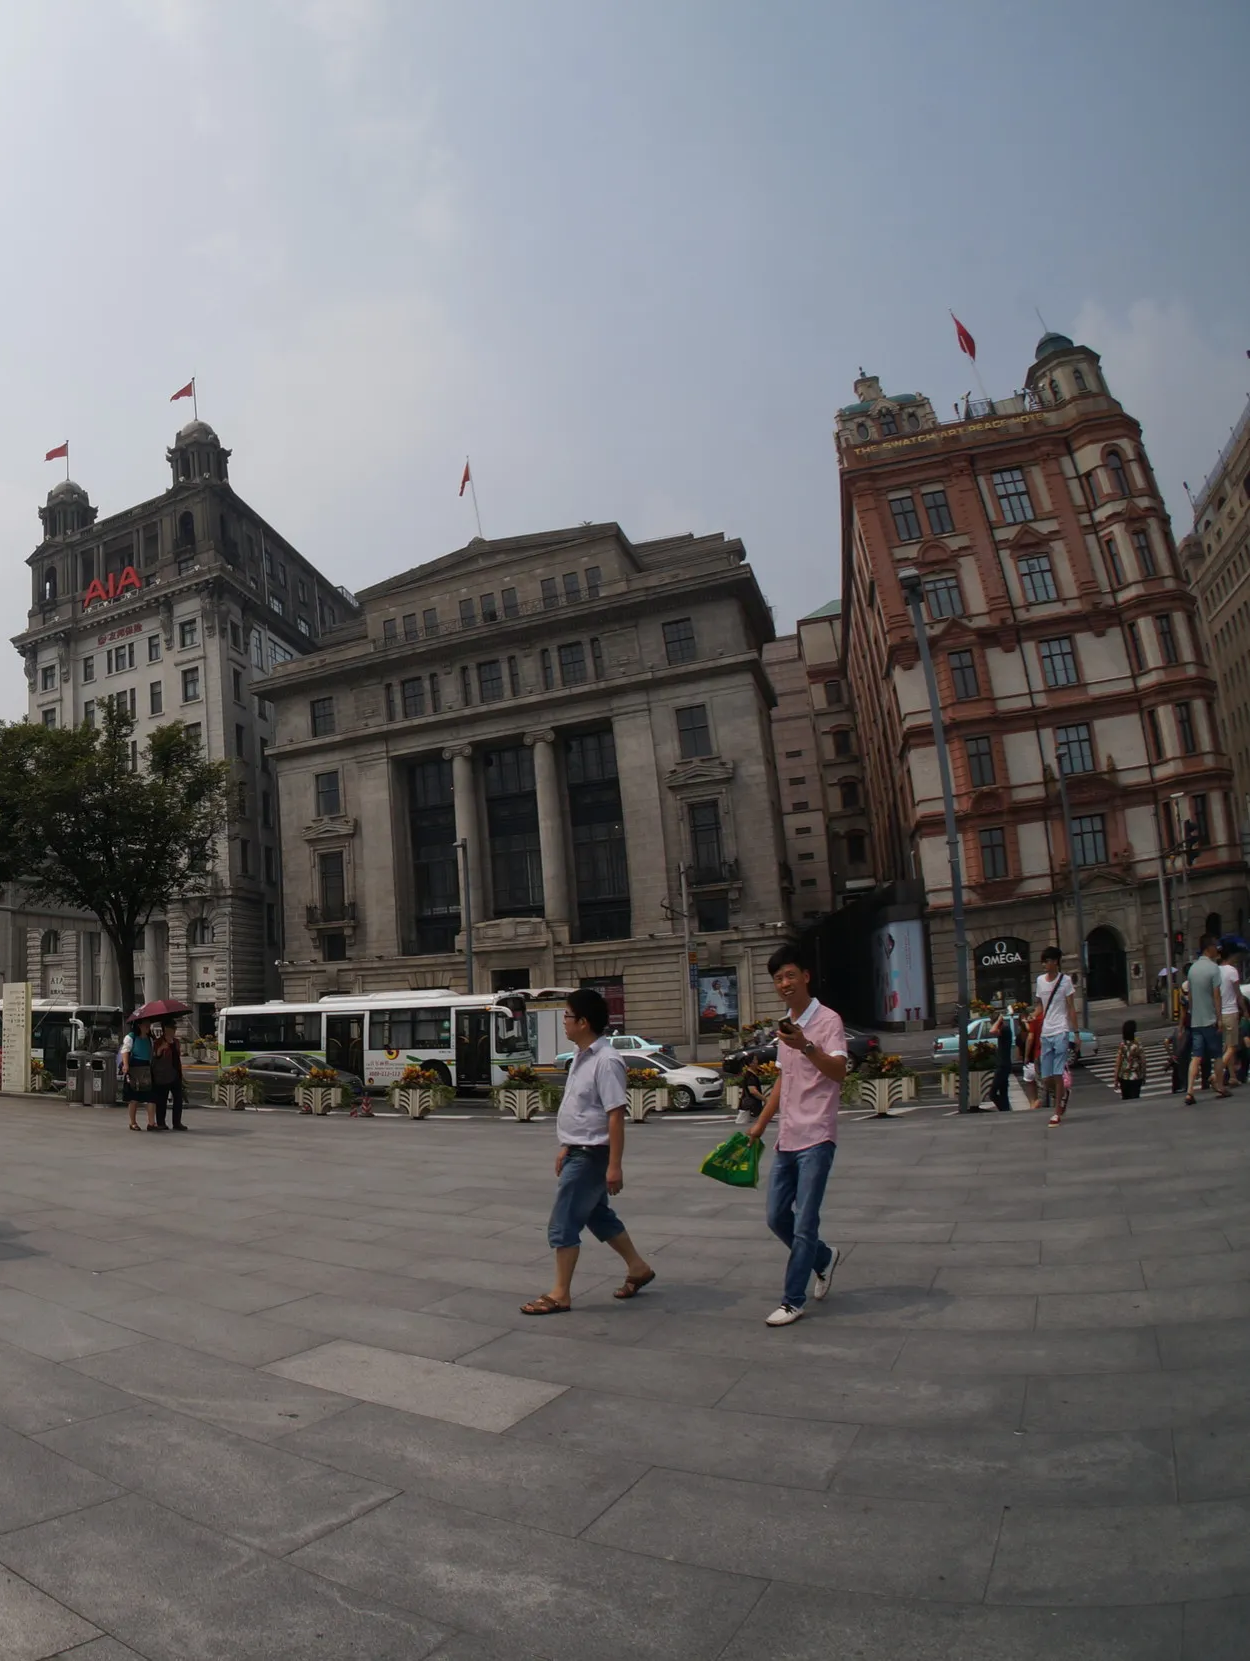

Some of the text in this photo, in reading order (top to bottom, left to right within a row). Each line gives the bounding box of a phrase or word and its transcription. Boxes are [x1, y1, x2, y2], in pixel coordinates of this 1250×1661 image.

[854, 444, 878, 455] THE
[882, 433, 936, 449] SWATCH
[940, 427, 964, 438] ART
[968, 419, 1008, 432] PEACE
[83, 566, 142, 608] AIA
[981, 952, 1022, 966] OMEGA
